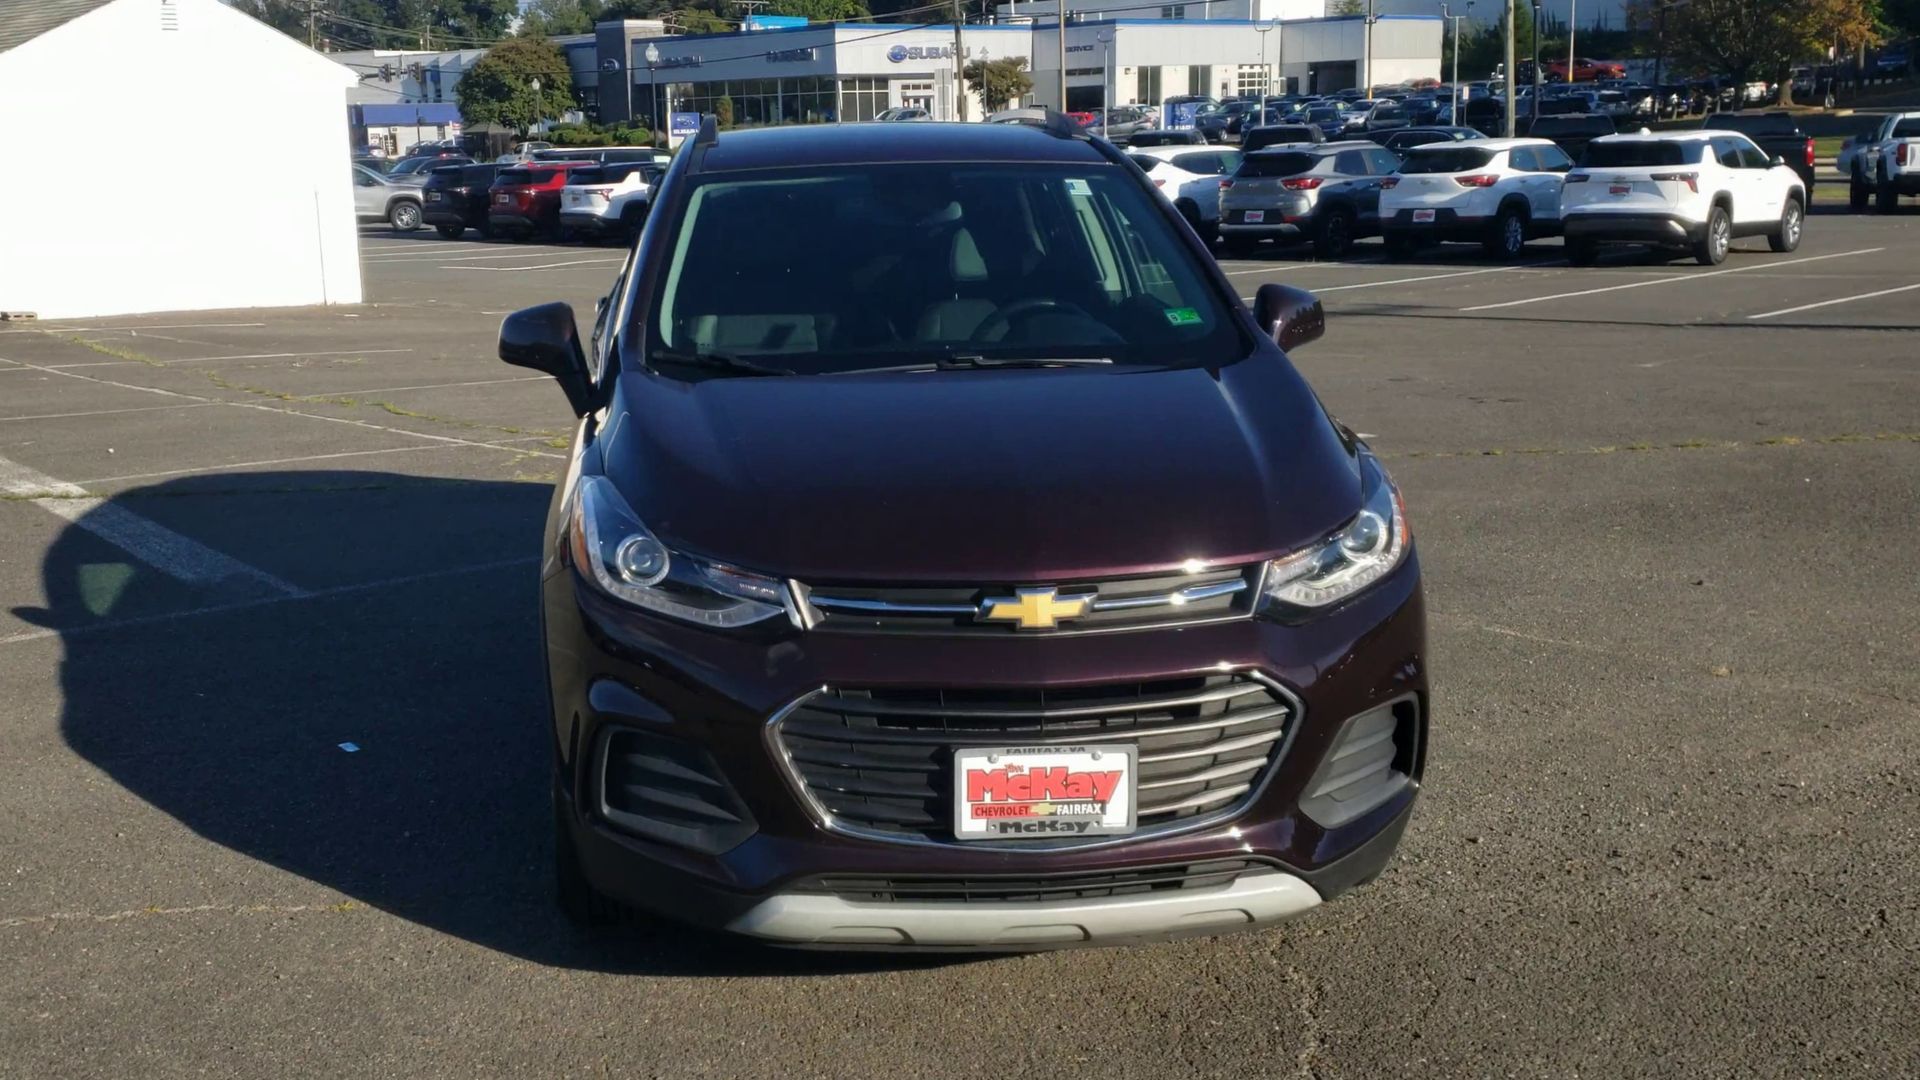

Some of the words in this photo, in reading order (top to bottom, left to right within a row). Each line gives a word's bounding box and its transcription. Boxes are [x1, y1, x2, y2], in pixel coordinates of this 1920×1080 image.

[966, 766, 1123, 804] McKay
[975, 805, 1030, 817] CHEVROLET
[1056, 803, 1102, 816] FAIRFAX
[999, 820, 1090, 834] McKay
